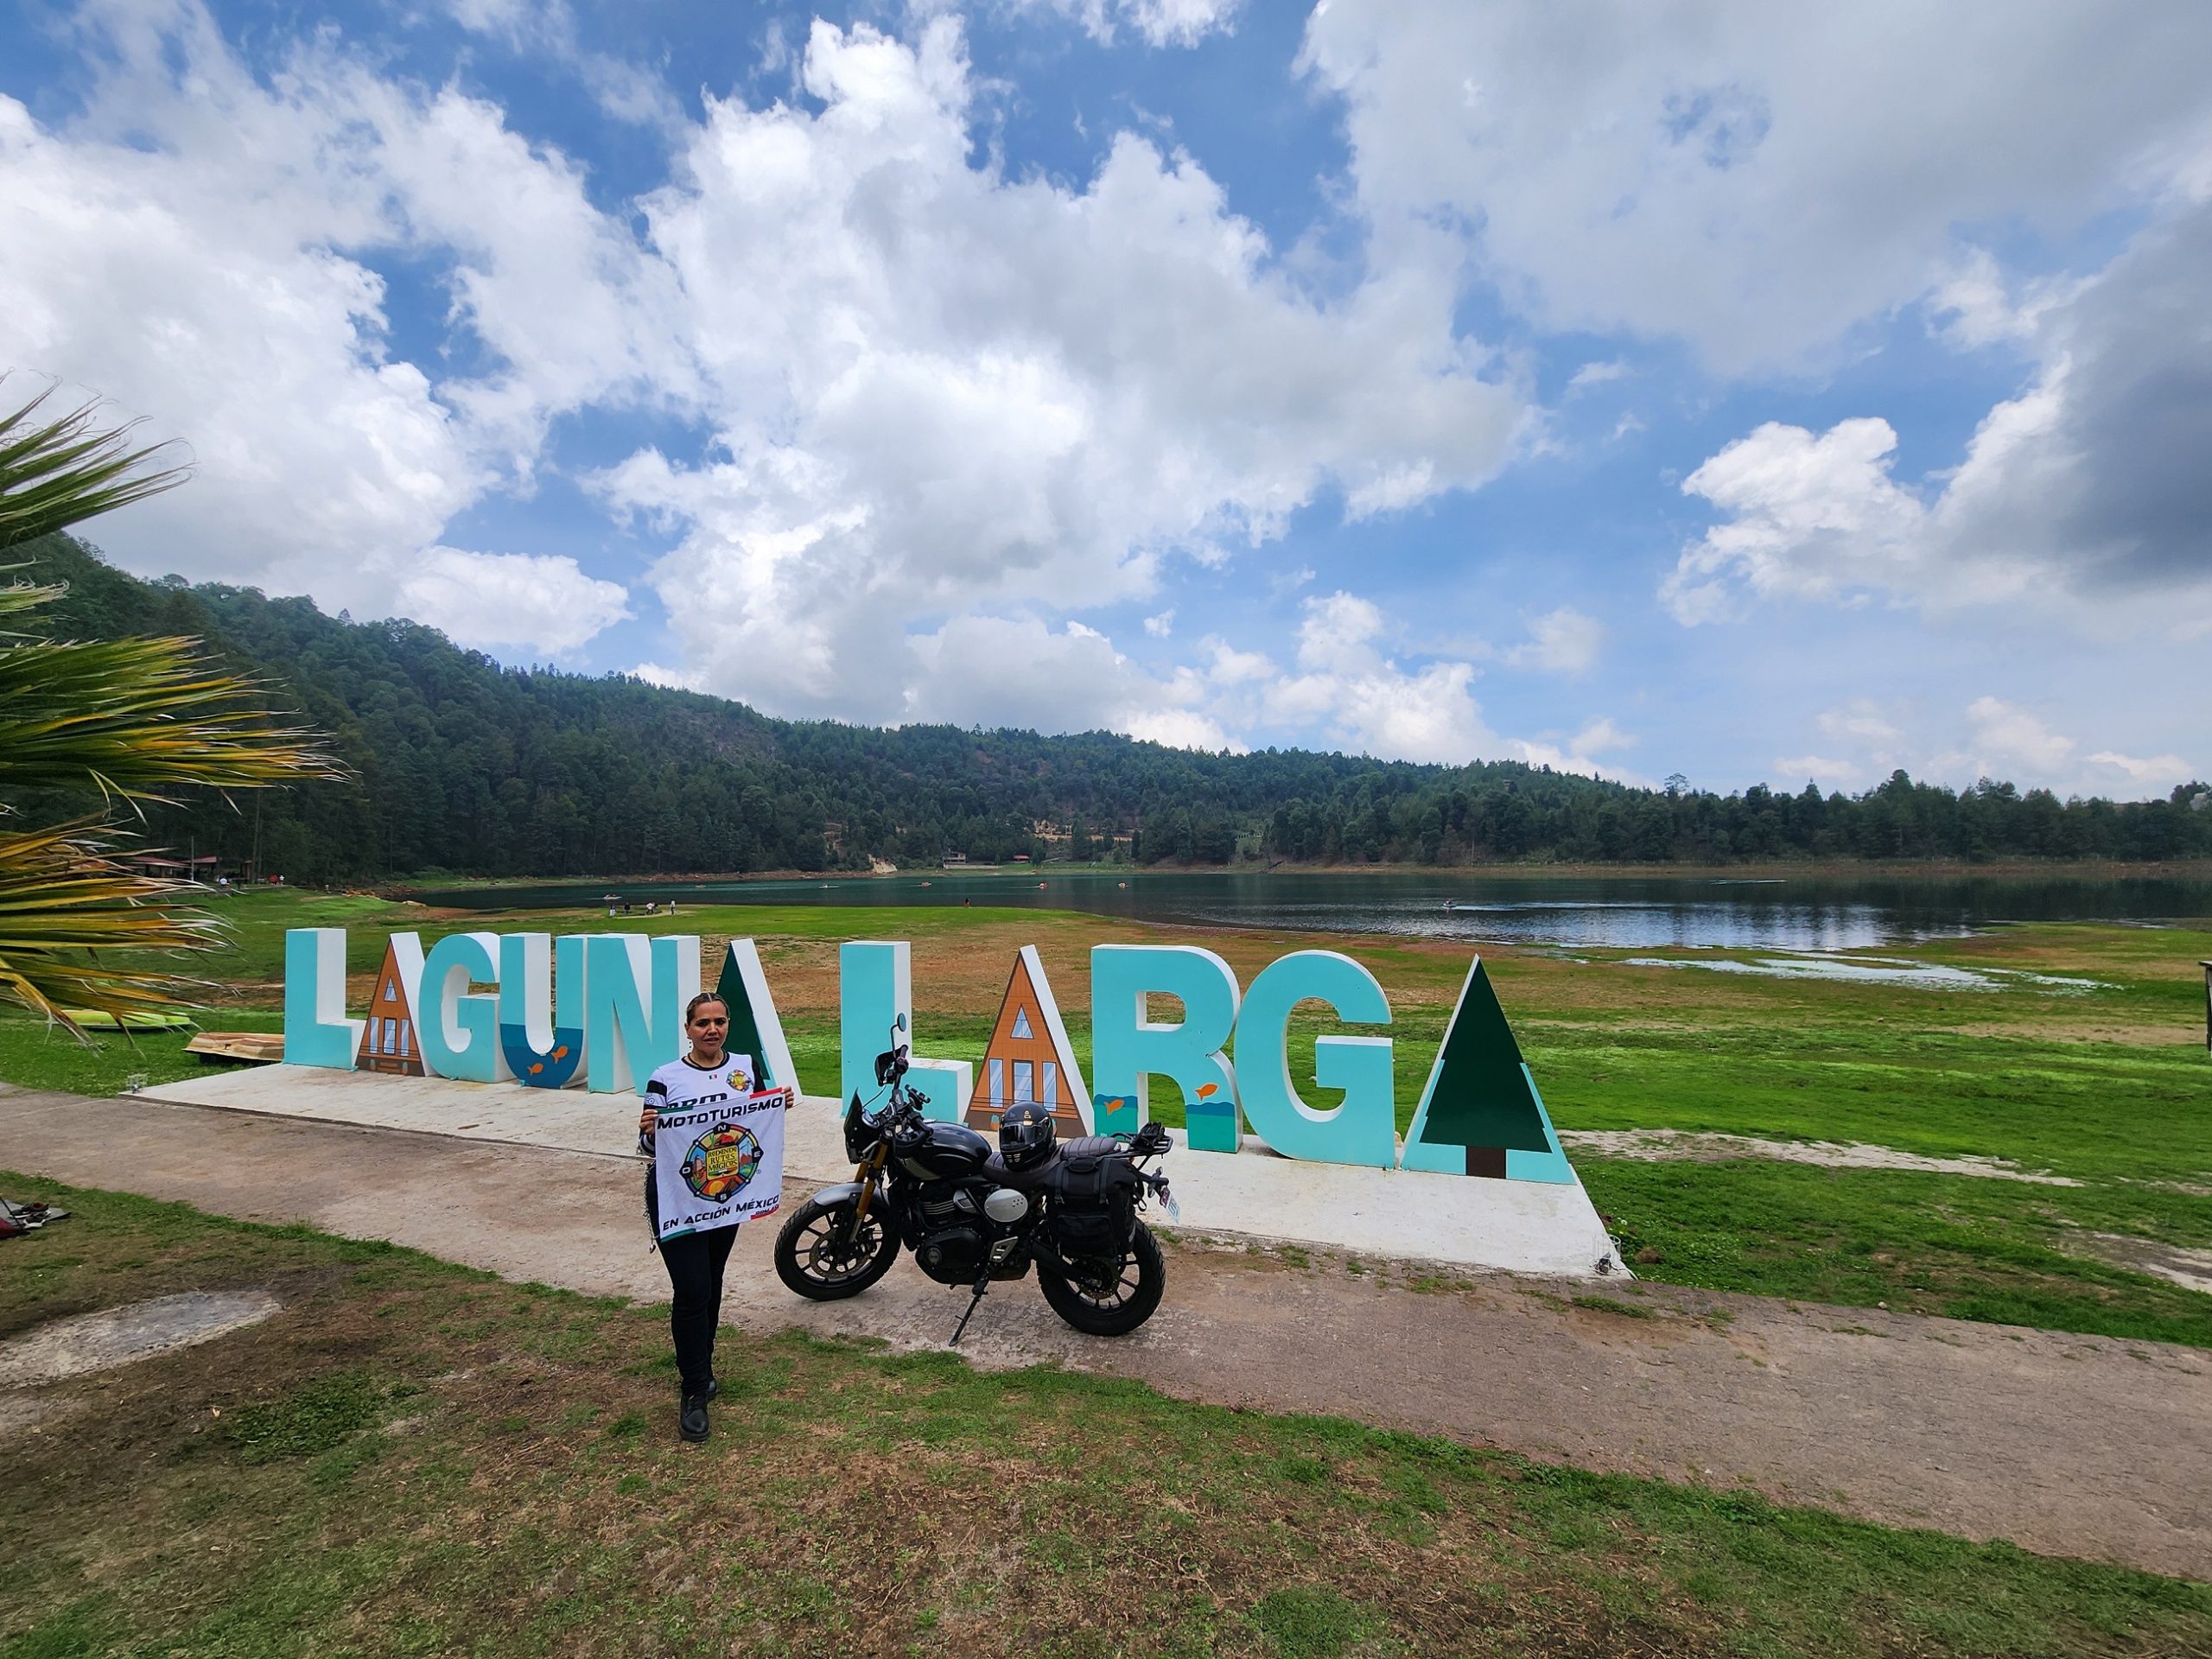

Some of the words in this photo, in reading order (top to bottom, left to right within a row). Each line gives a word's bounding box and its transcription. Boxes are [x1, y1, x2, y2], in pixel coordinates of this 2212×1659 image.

[283, 928, 801, 1106] LAGUNA
[841, 941, 1577, 1185] LARGA
[657, 1096, 783, 1129] MOTOTURISMO
[663, 1217, 679, 1231] EN
[684, 1205, 731, 1224] ACCIÓN
[736, 1194, 779, 1212] MÉXICO
